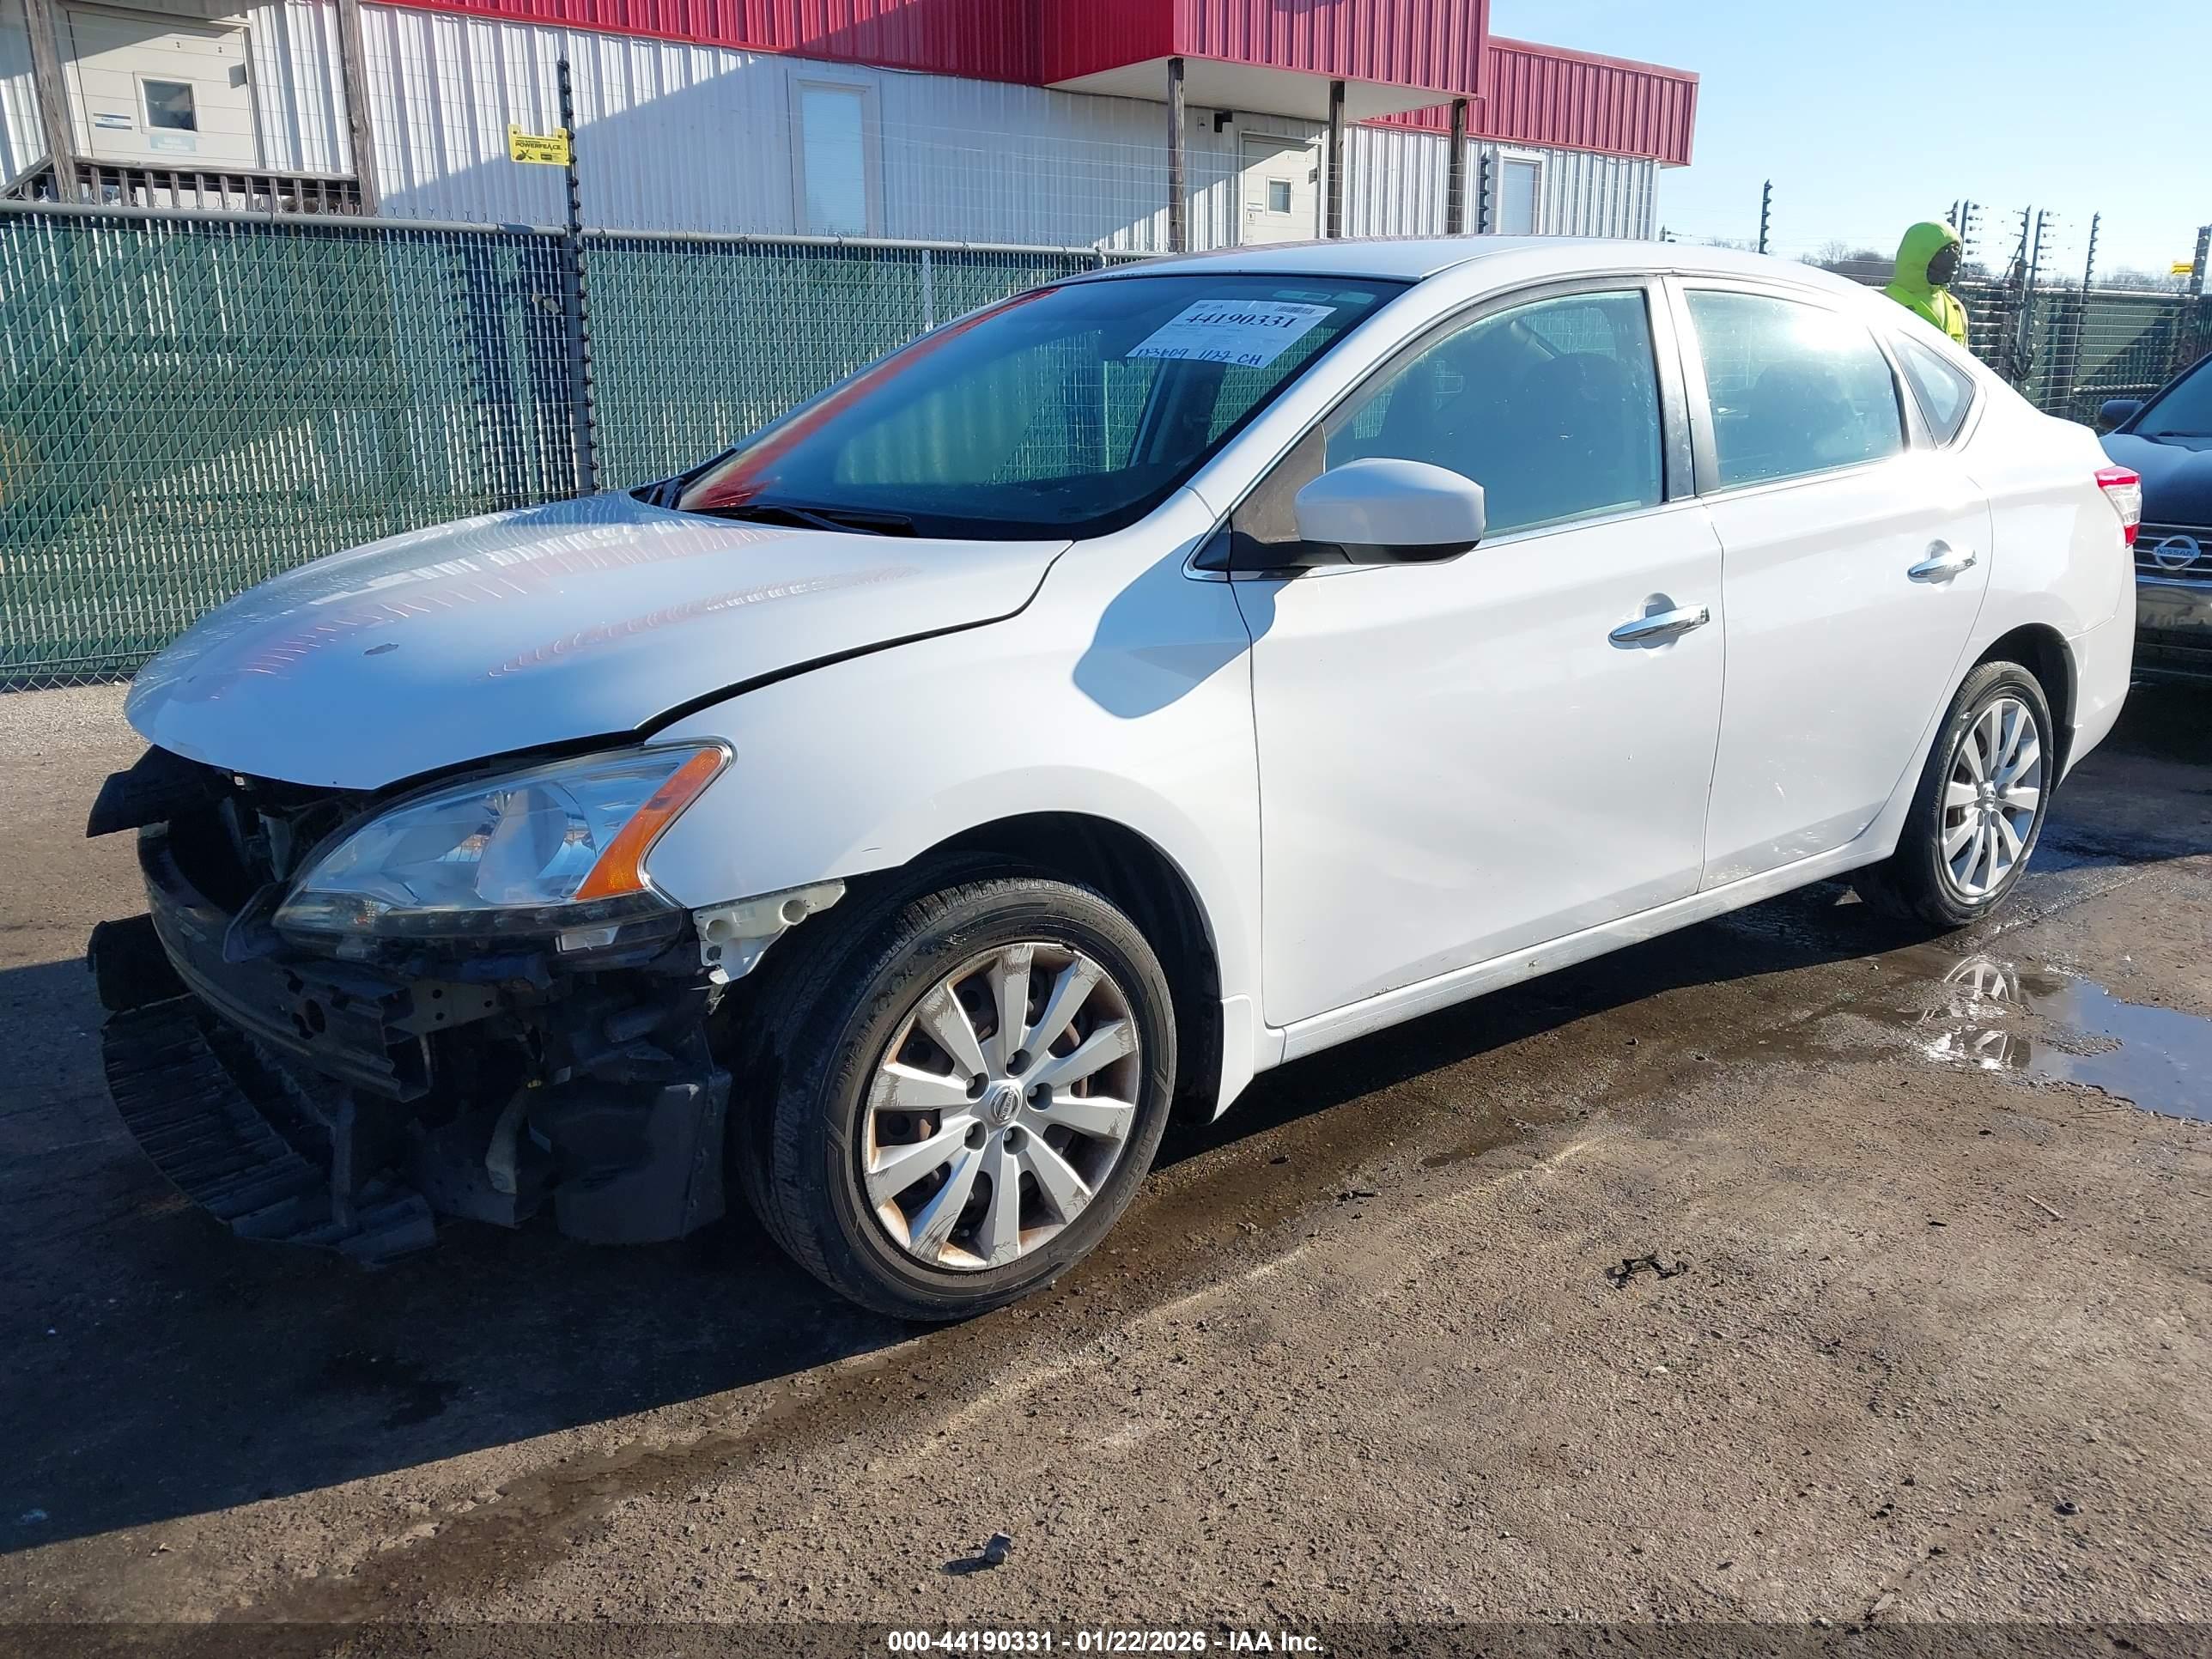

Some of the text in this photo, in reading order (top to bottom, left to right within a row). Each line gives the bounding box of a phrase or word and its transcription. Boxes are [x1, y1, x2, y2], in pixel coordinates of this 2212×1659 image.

[1185, 313, 1297, 328] 44190331
[1237, 353, 1263, 365] CH
[2156, 548, 2195, 556] NISSAN
